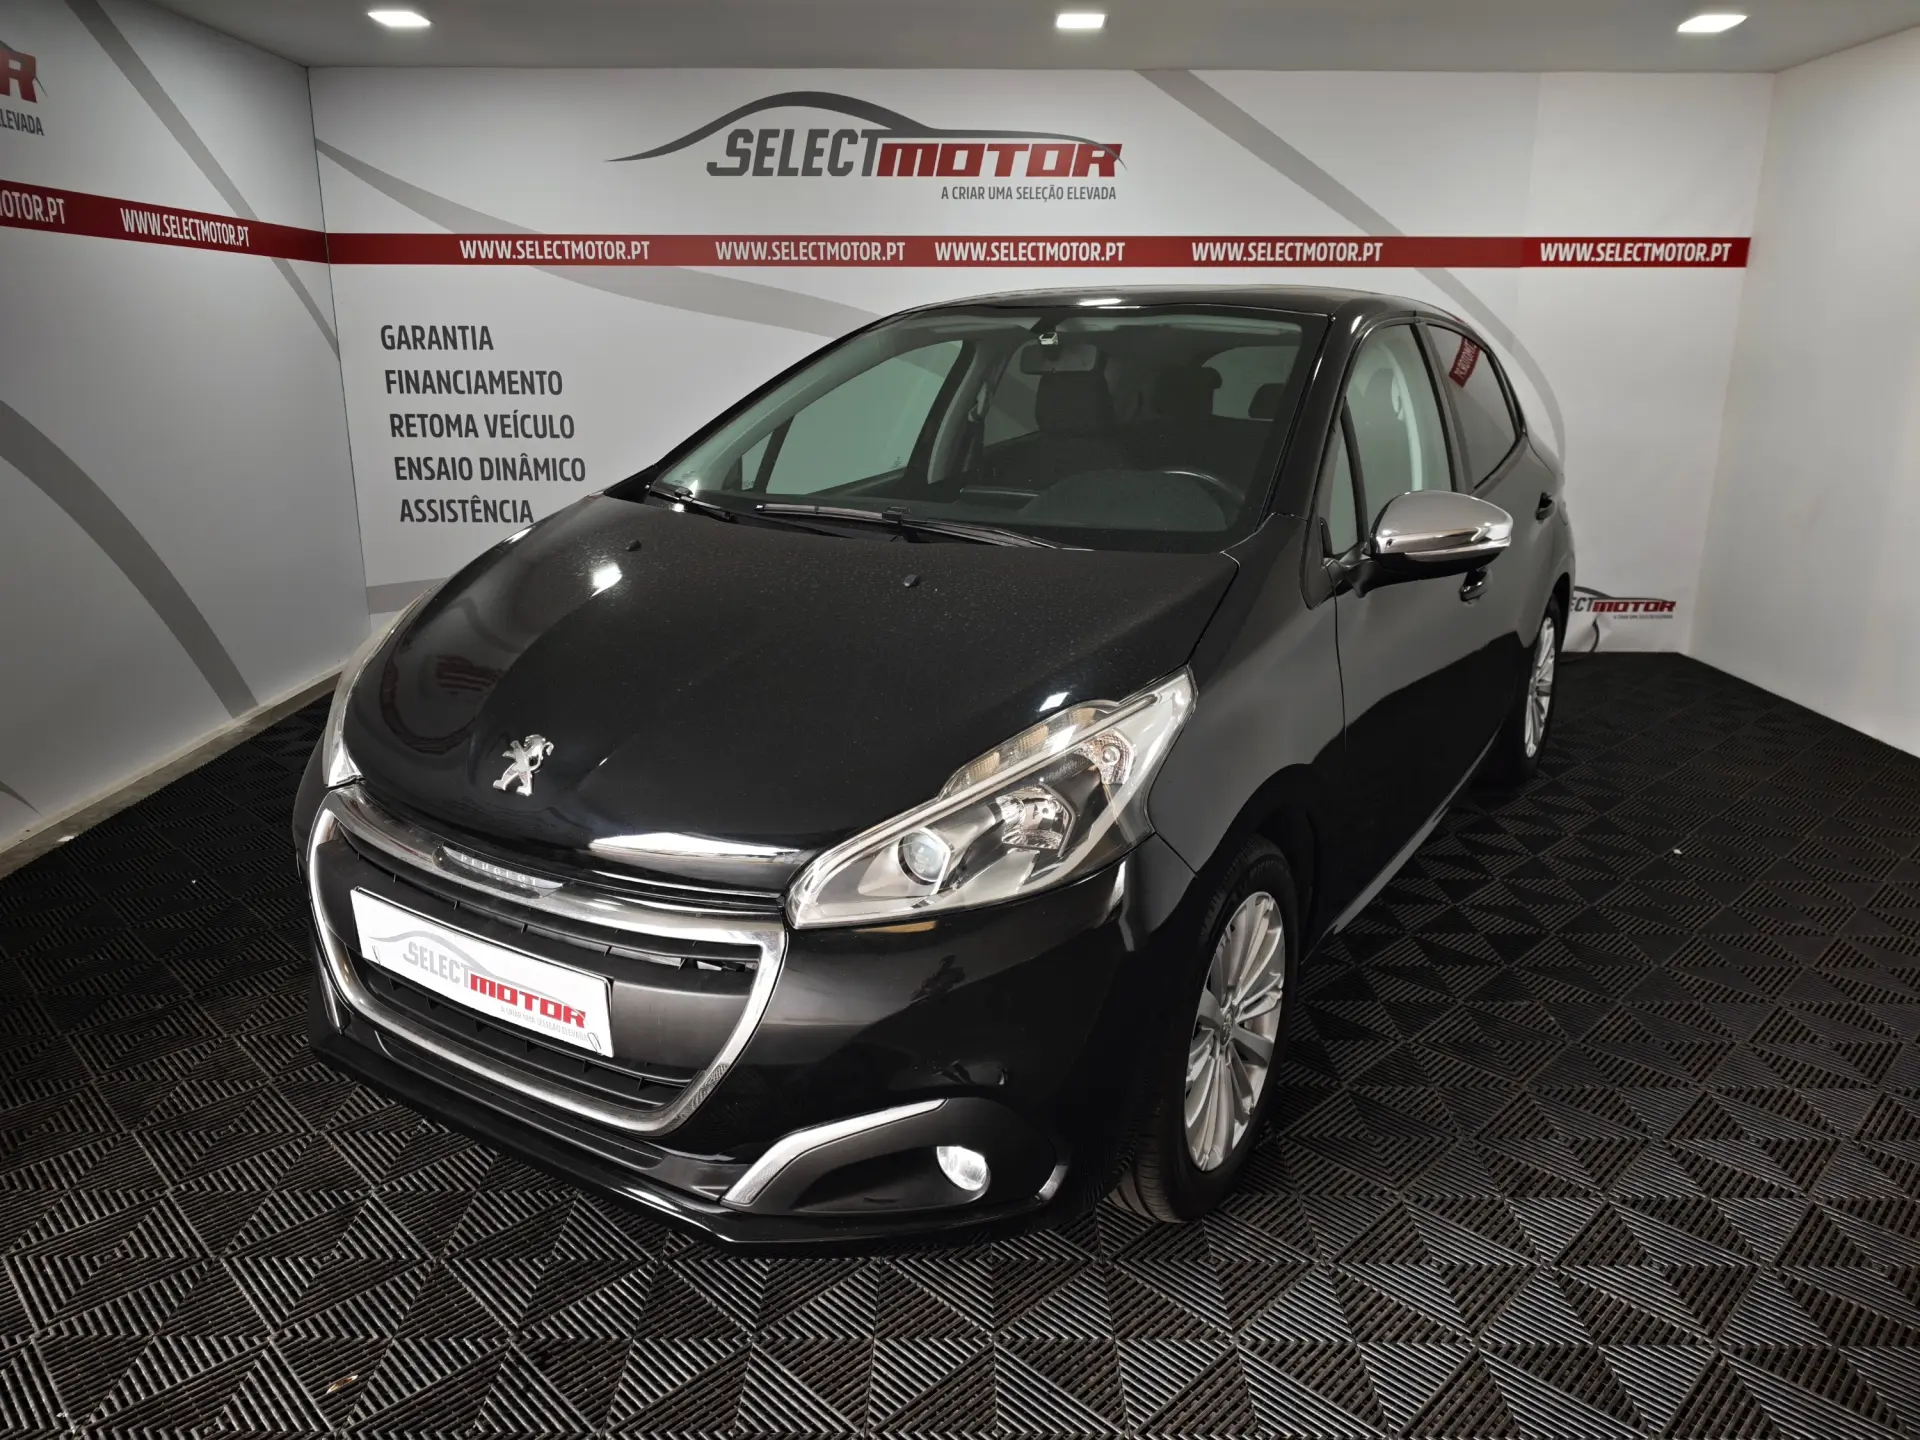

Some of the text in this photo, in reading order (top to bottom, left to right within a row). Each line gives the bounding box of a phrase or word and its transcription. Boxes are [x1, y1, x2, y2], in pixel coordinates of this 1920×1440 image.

[941, 184, 1117, 203] A CRIAR UMA SELEÇÃO ELEVADA
[0, 189, 66, 225] OTOR.PT
[120, 207, 250, 248] WWW.SELECTMOTOR.PT
[460, 239, 650, 261] WWW.SELECTMOTOR.PT
[715, 241, 906, 262] WWW.SELECTMOTOR.PT
[935, 241, 1125, 262] WWW.SELECTMOTOR.PT
[1191, 242, 1383, 262] WWW.SELECTMOTOR.PT
[1540, 242, 1733, 262] WWW.SELECTMOTOR.PT
[380, 325, 494, 351] GARANTIA
[385, 369, 563, 395] FINANCIAMENTO
[389, 409, 575, 439] RETOMA VEÍCULO
[394, 452, 586, 482] ENSAIO DINÂMICO
[400, 494, 535, 524] ASSISTÊNCIA
